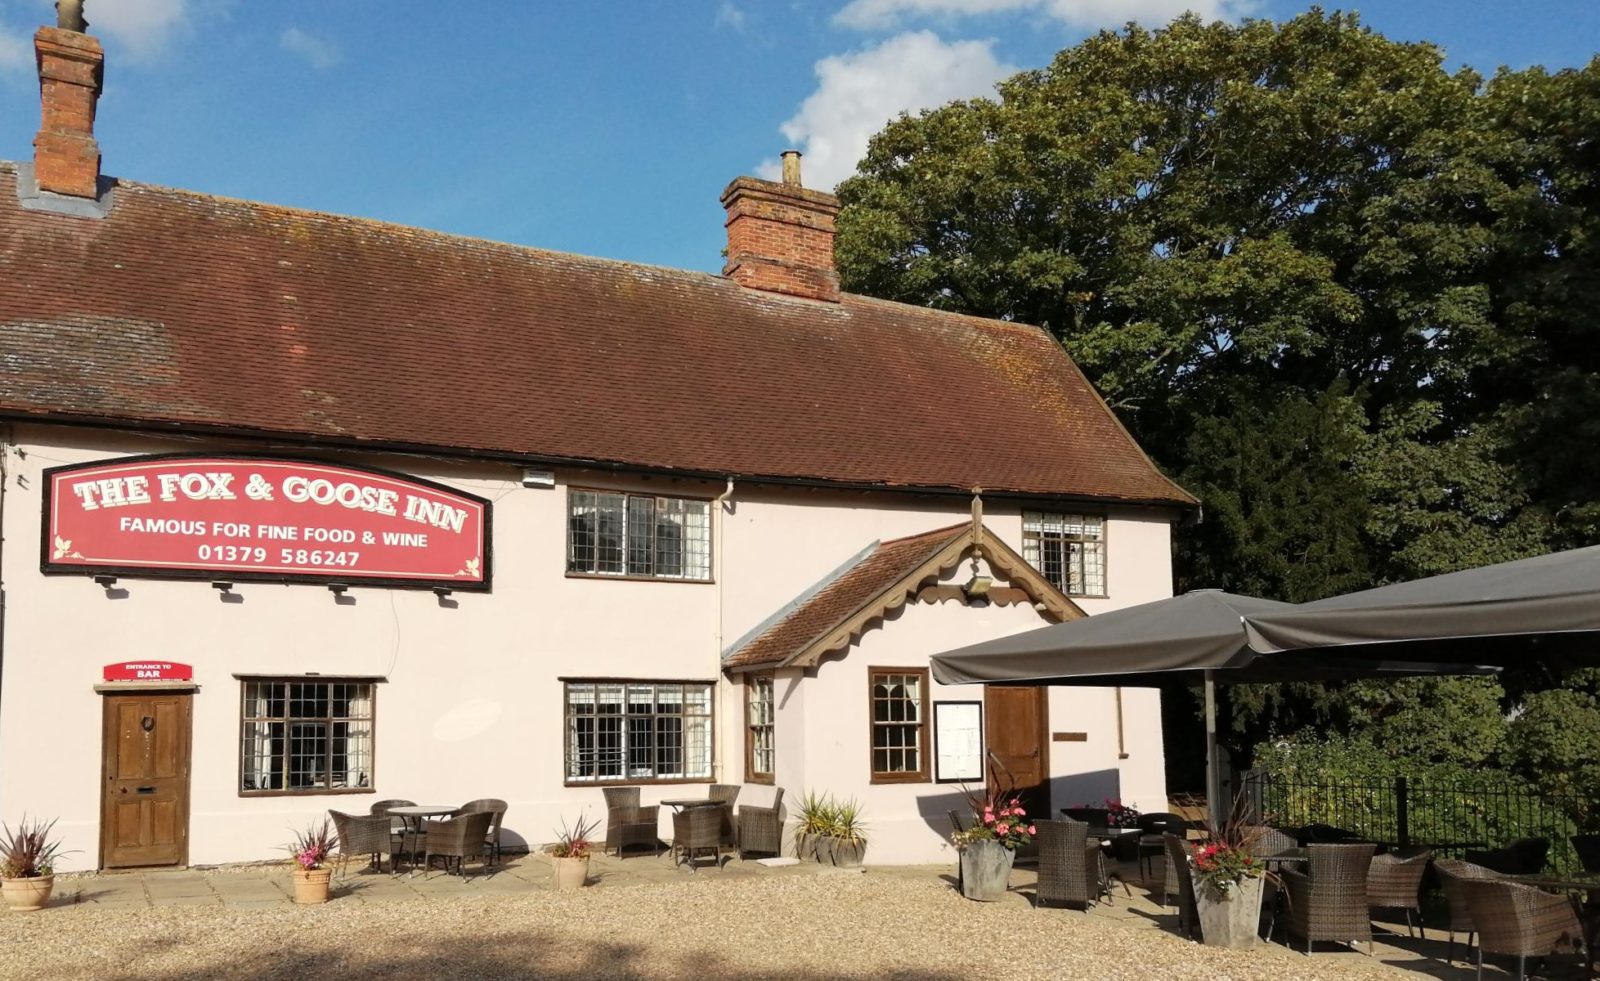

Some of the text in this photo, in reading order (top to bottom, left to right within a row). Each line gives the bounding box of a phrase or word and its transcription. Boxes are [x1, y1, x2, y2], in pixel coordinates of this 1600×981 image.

[72, 472, 468, 534] THE FOX & GOOSE INN
[120, 516, 428, 547] FAMOUS FOR FINE FOOD & WINE
[198, 544, 360, 566] 01379 586247
[137, 670, 160, 678] BAR
